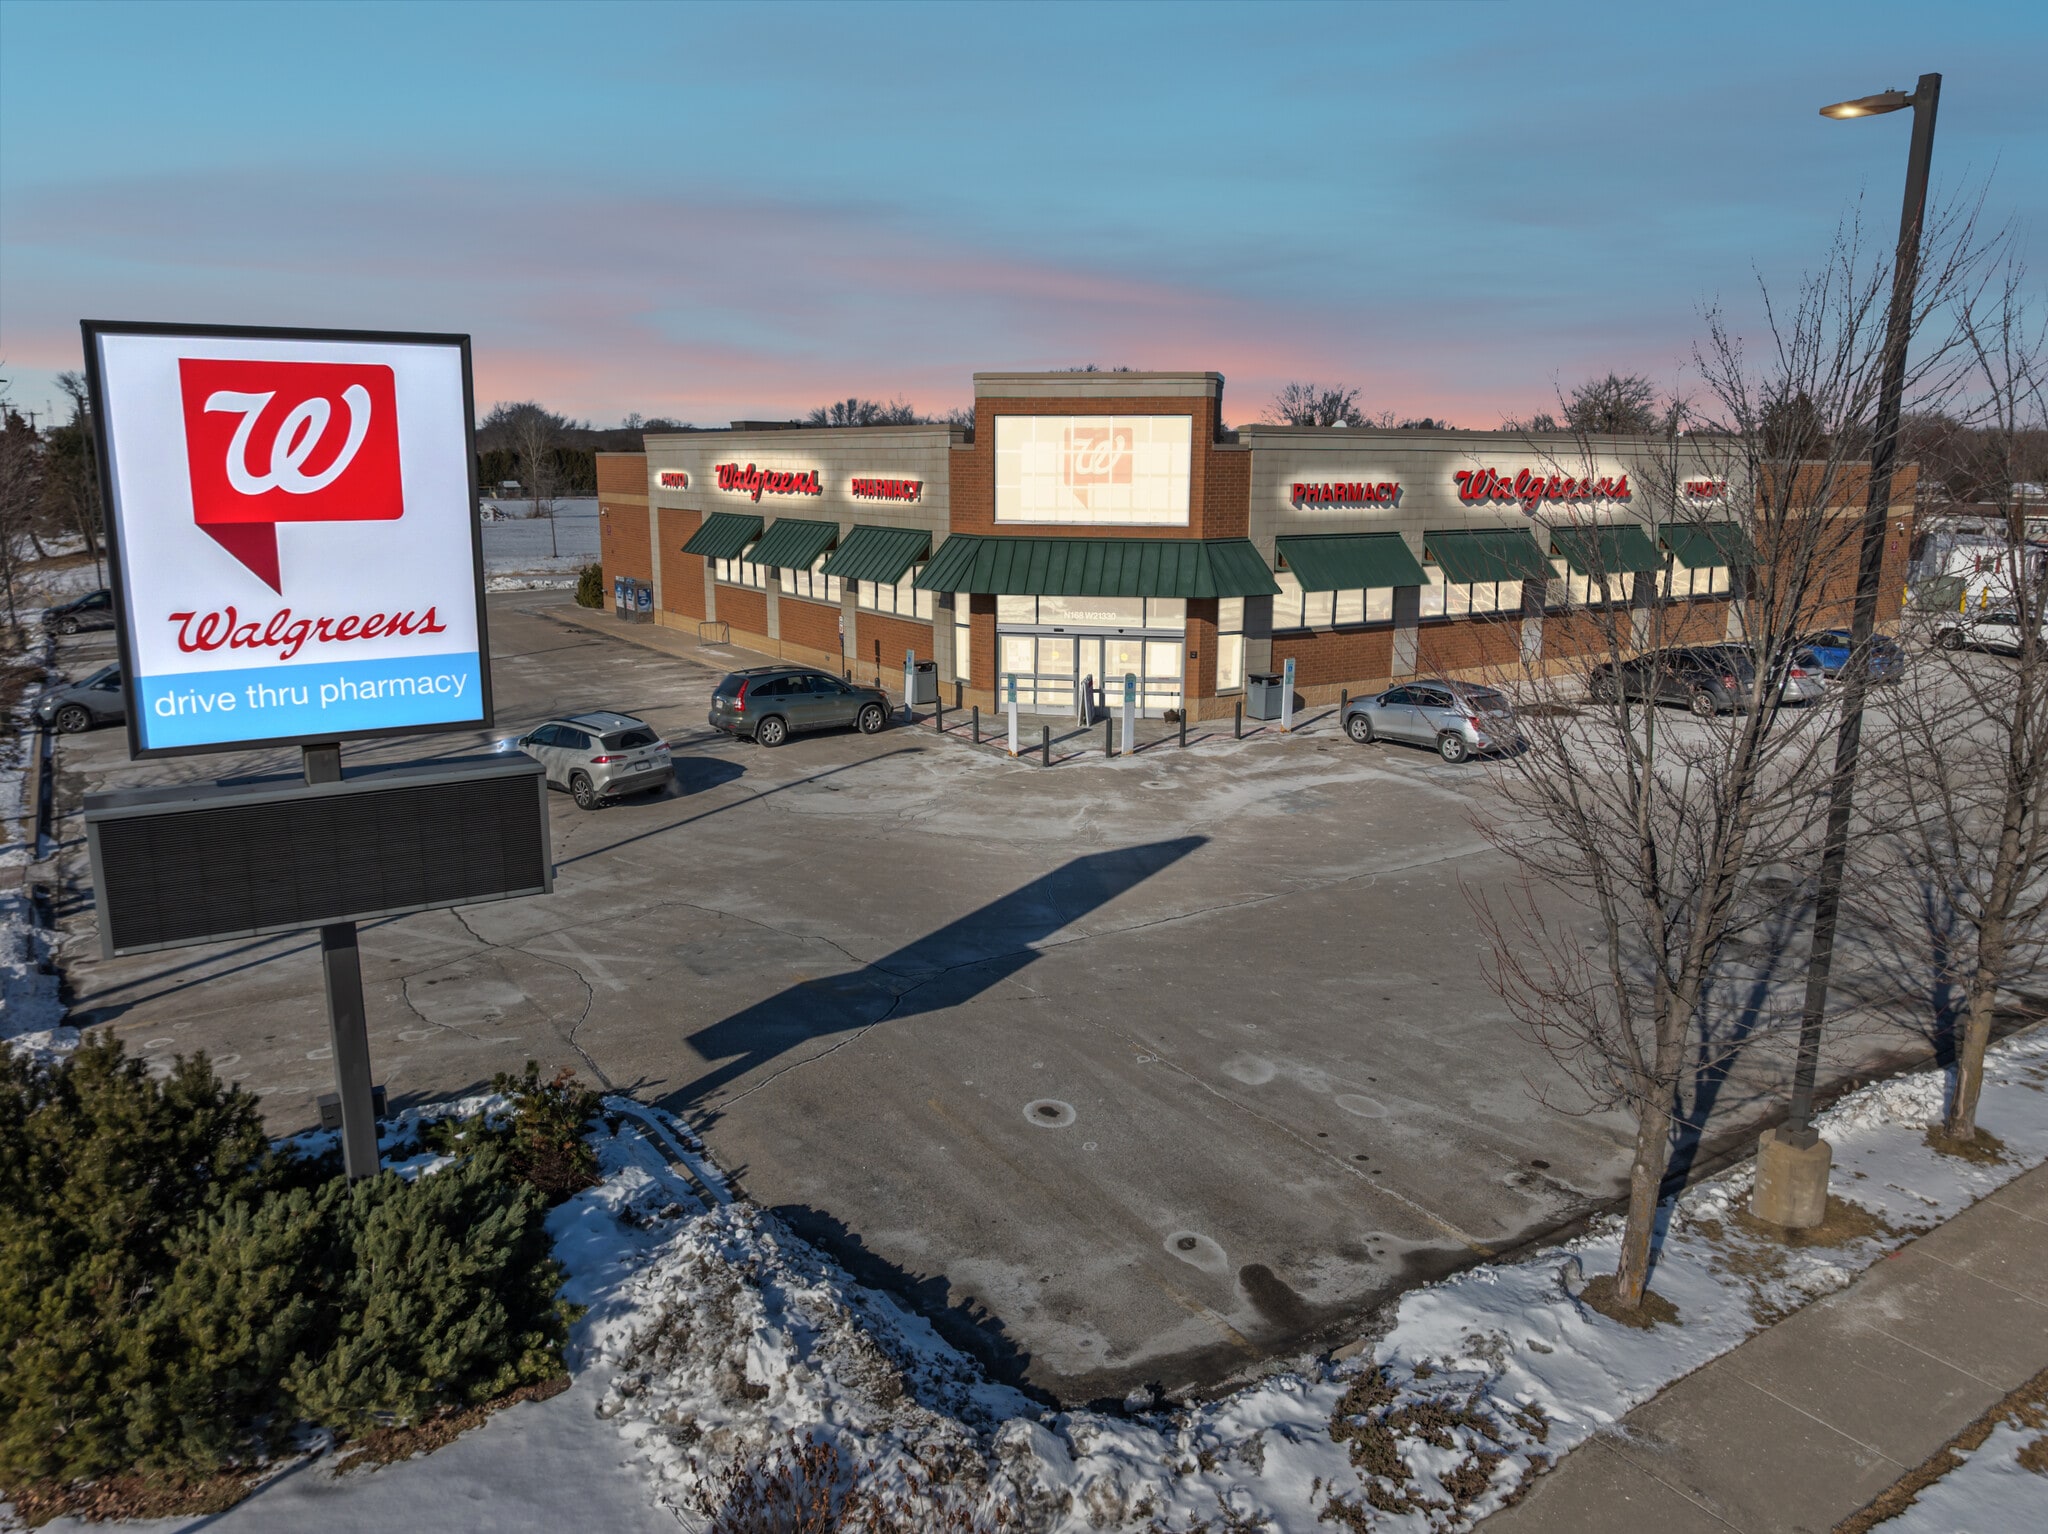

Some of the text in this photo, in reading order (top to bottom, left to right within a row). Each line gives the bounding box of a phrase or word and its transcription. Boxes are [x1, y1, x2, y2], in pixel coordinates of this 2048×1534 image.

[714, 463, 820, 502] Walgreens
[851, 478, 920, 500] PHARMACY
[1293, 482, 1400, 503] PHARMACY
[1455, 467, 1632, 511] Walgreens
[169, 606, 446, 661] Walgreens
[155, 673, 468, 718] drive thru pharmacy
